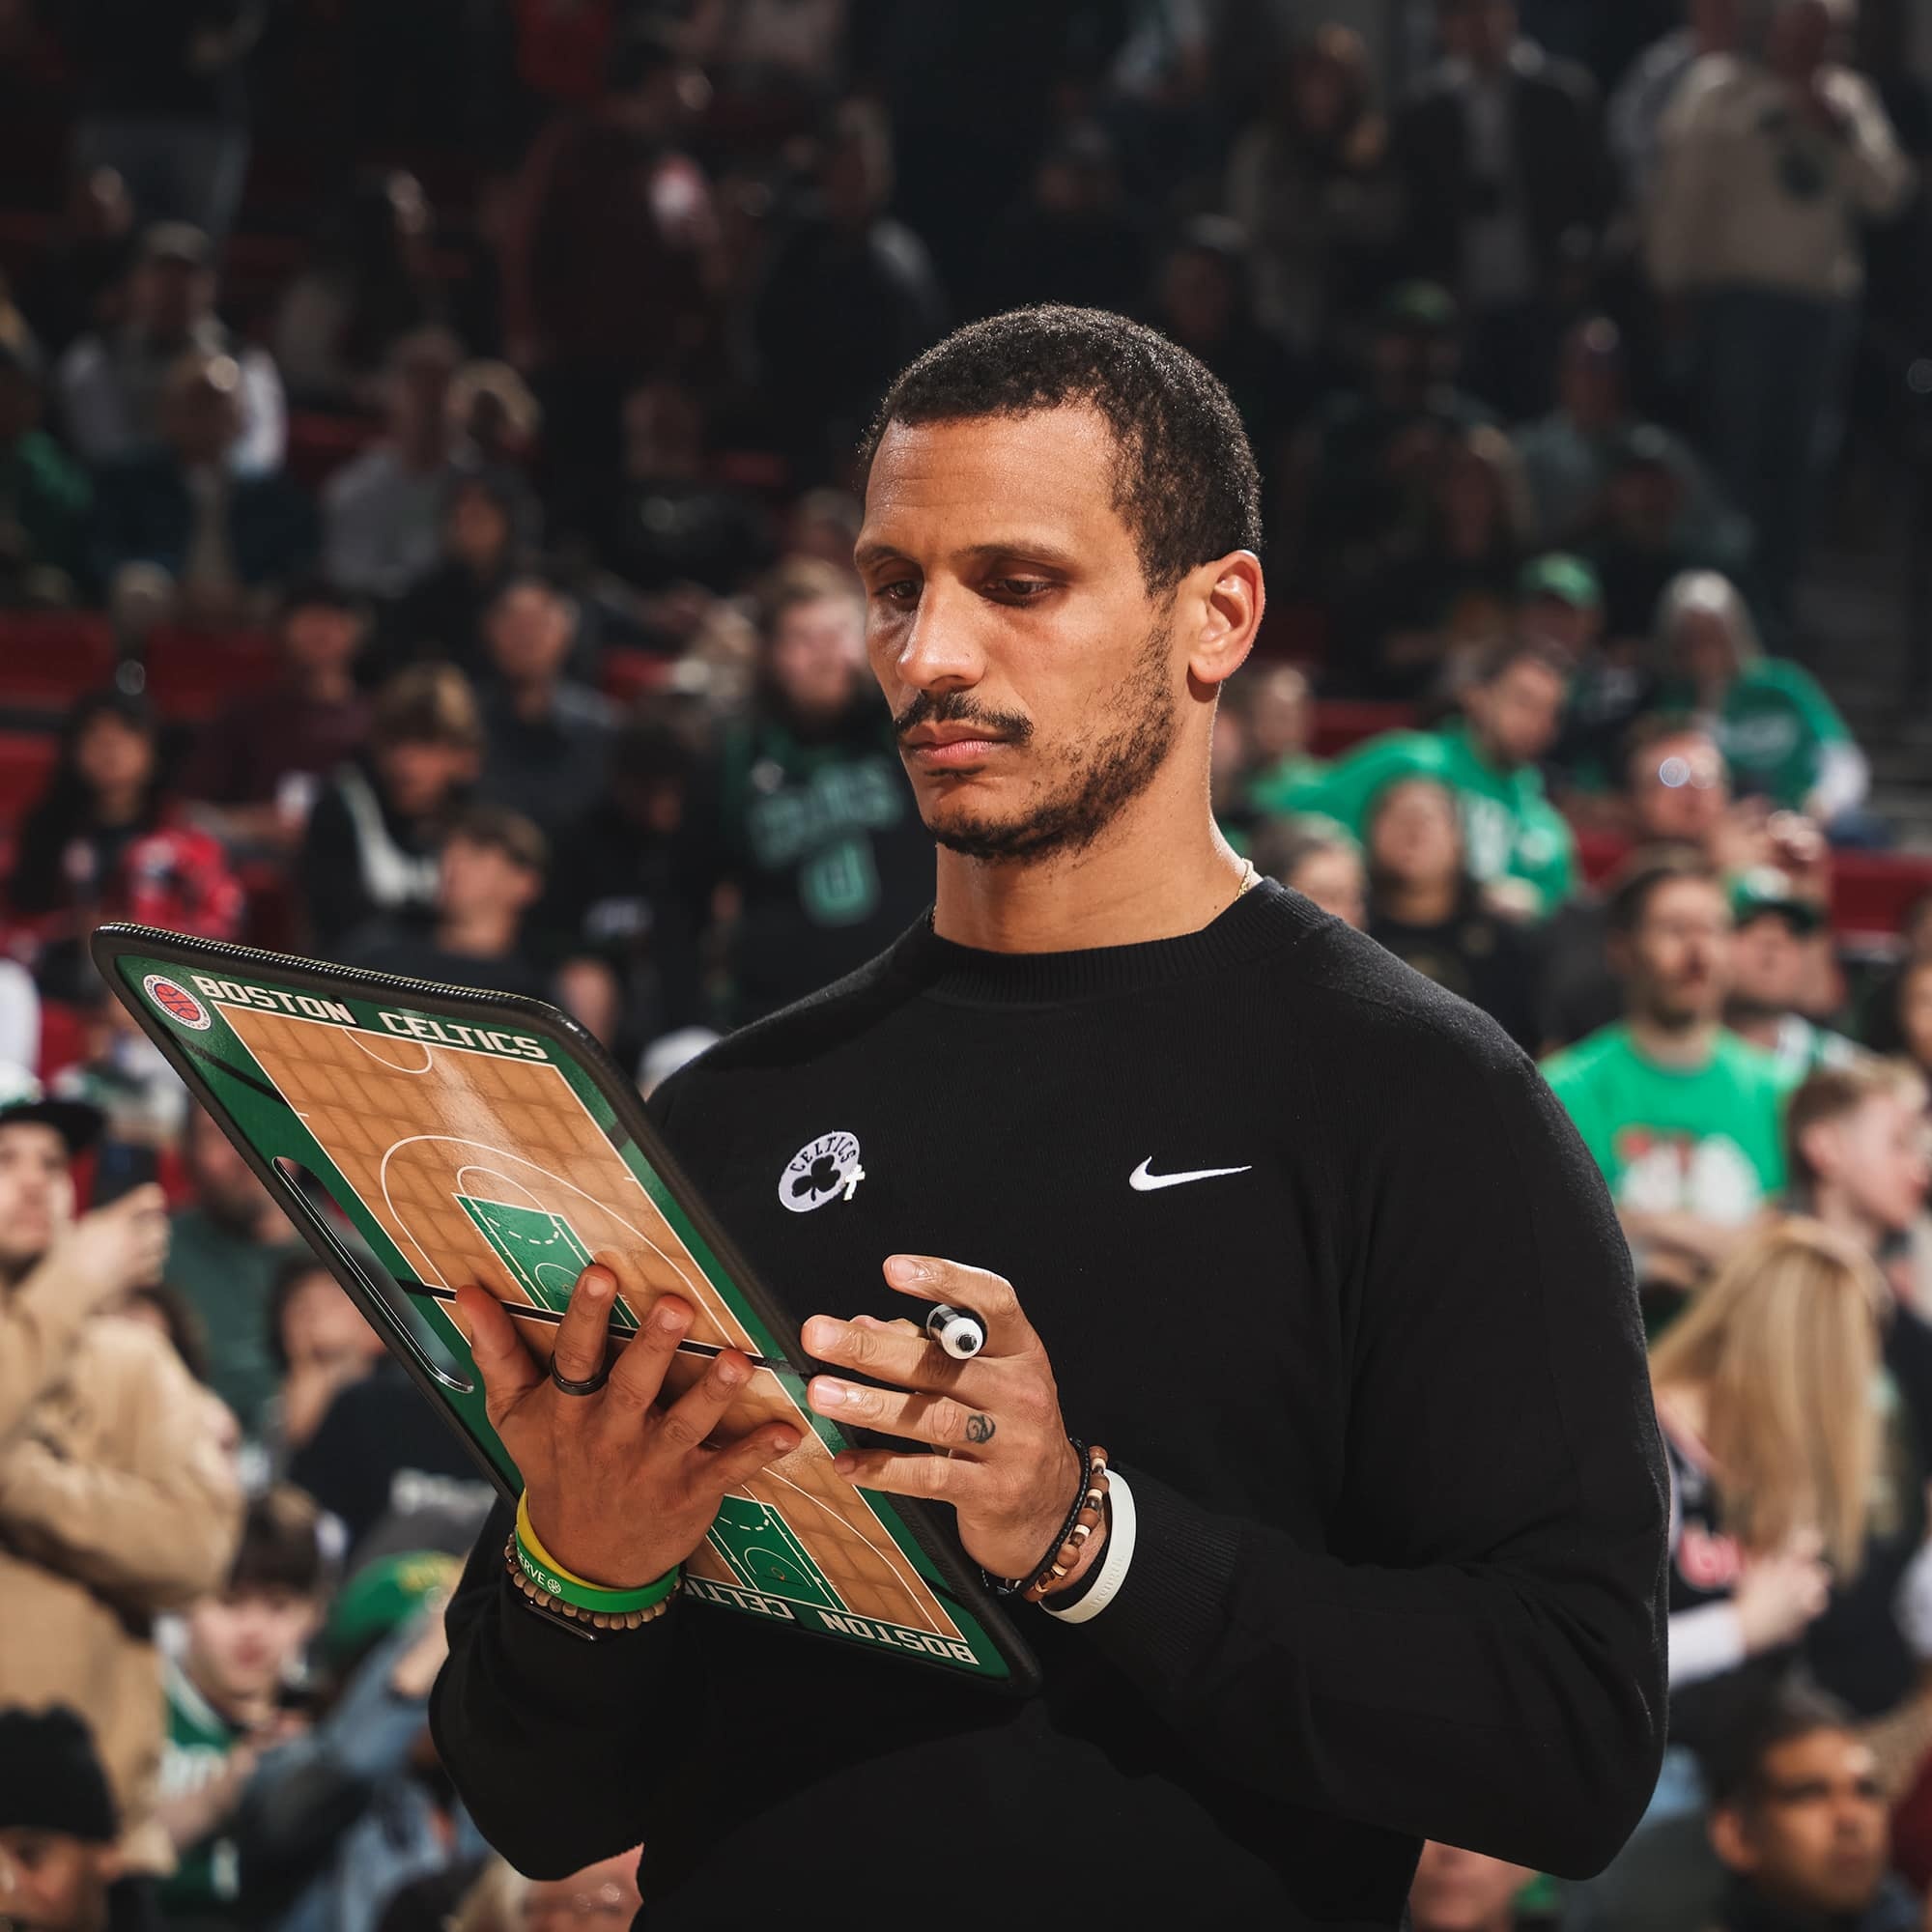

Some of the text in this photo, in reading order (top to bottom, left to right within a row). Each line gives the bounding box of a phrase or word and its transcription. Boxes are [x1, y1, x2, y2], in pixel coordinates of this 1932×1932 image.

[190, 975, 356, 1025] BOSTON
[378, 1011, 548, 1059] CELTICS
[789, 1136, 857, 1172] CELTICS
[684, 1579, 980, 1665] BOSTON CELTI
